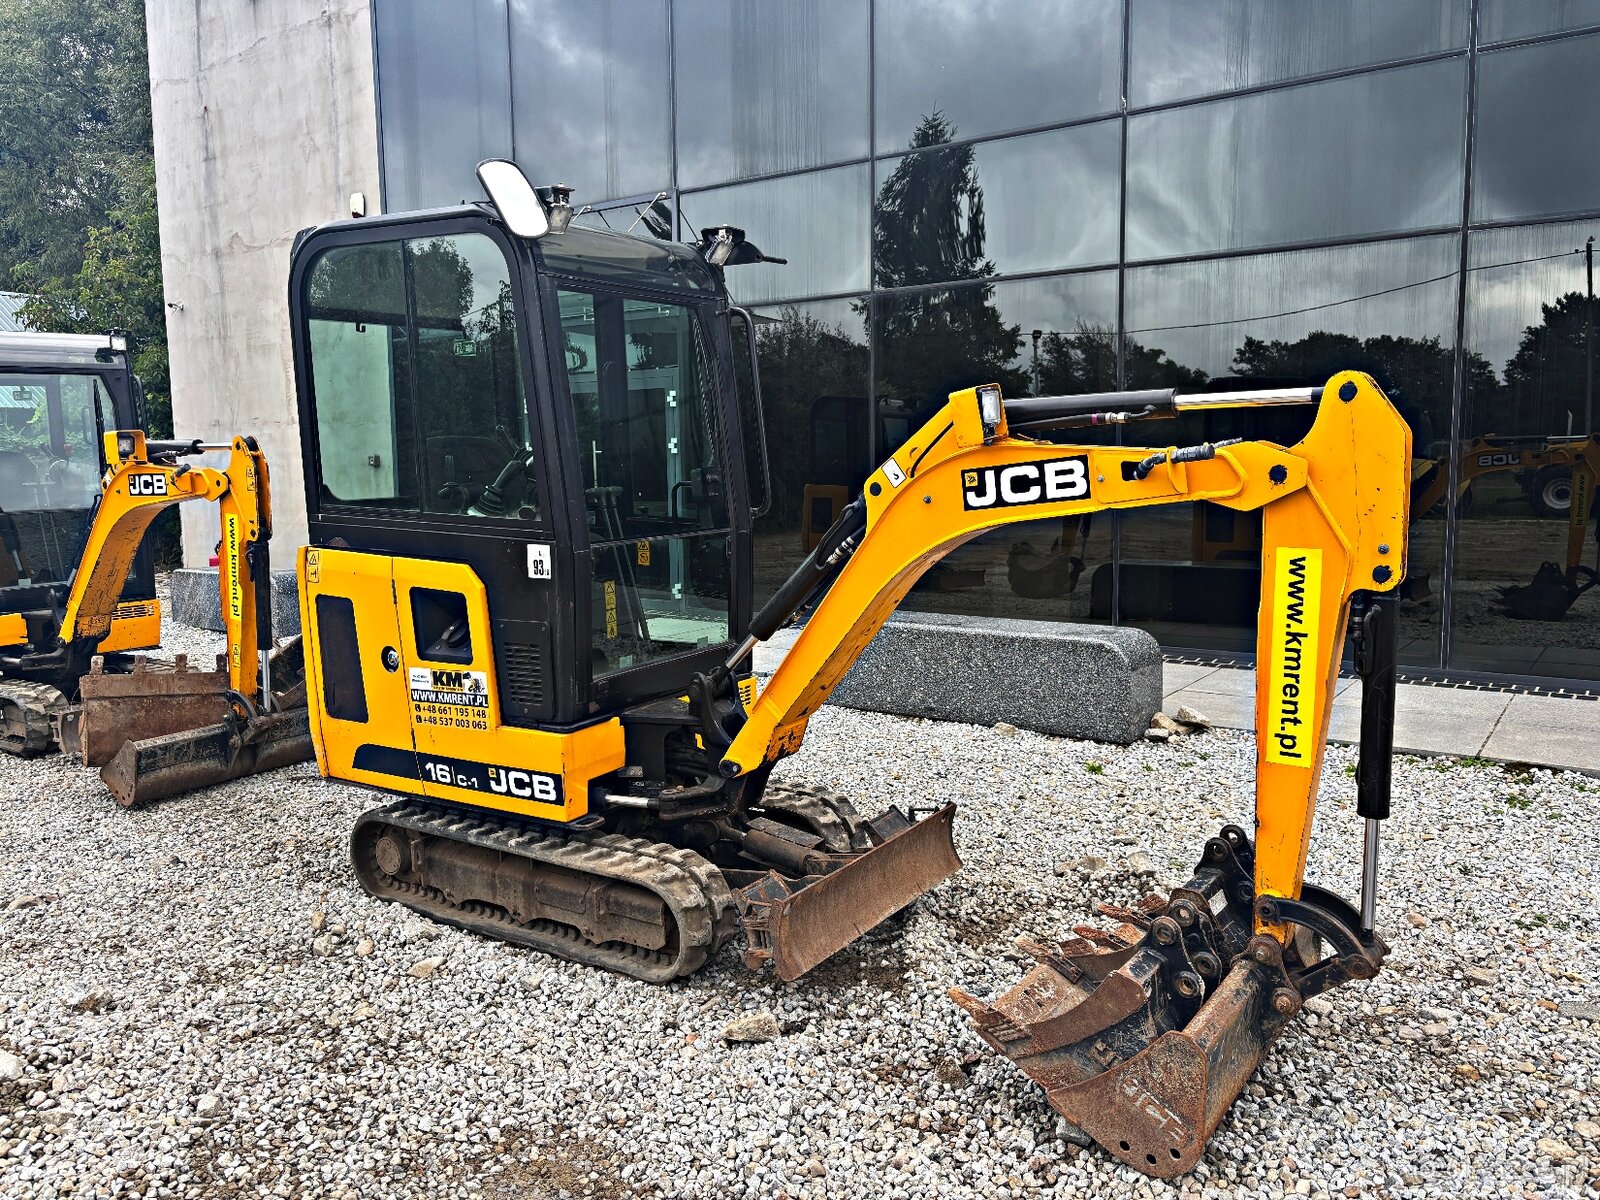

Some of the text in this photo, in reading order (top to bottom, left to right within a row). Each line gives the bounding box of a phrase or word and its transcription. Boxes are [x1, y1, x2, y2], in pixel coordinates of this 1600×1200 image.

[130, 474, 166, 494] JCB
[966, 459, 1088, 508] JCB
[229, 517, 240, 617] www.kmrent.pl
[1274, 556, 1309, 758] www.kmrent.pl
[432, 671, 463, 687] KM
[411, 690, 488, 706] WWW.KMRENT.PL
[422, 704, 487, 719] +48 661 195 148
[423, 715, 488, 730] +48 537 003 063
[489, 768, 557, 801] JCB
